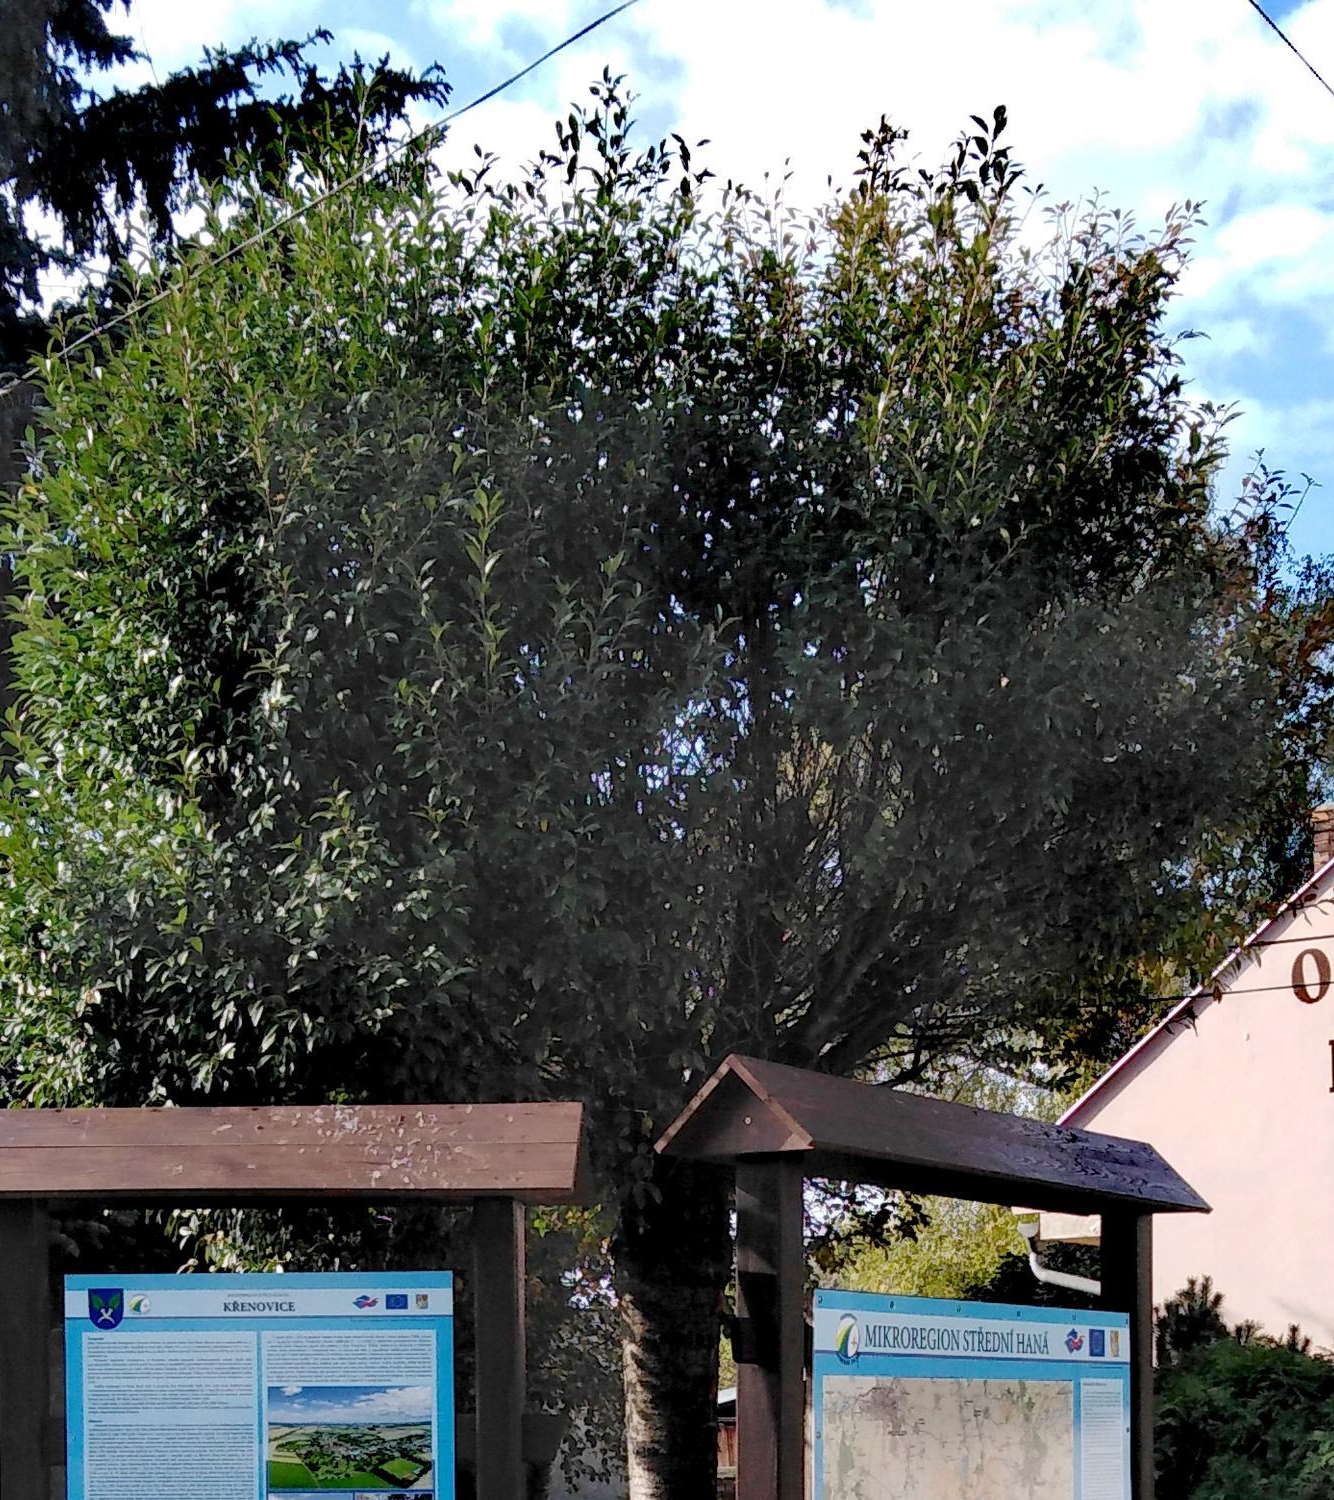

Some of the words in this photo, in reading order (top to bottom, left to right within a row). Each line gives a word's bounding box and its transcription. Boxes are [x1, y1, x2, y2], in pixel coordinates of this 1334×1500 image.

[223, 1300, 296, 1312] KŘENOVICE
[865, 1324, 961, 1350] MIKROREGION
[962, 1327, 1014, 1353] STŘEDNÍ
[1016, 1331, 1050, 1355] HANÁ
